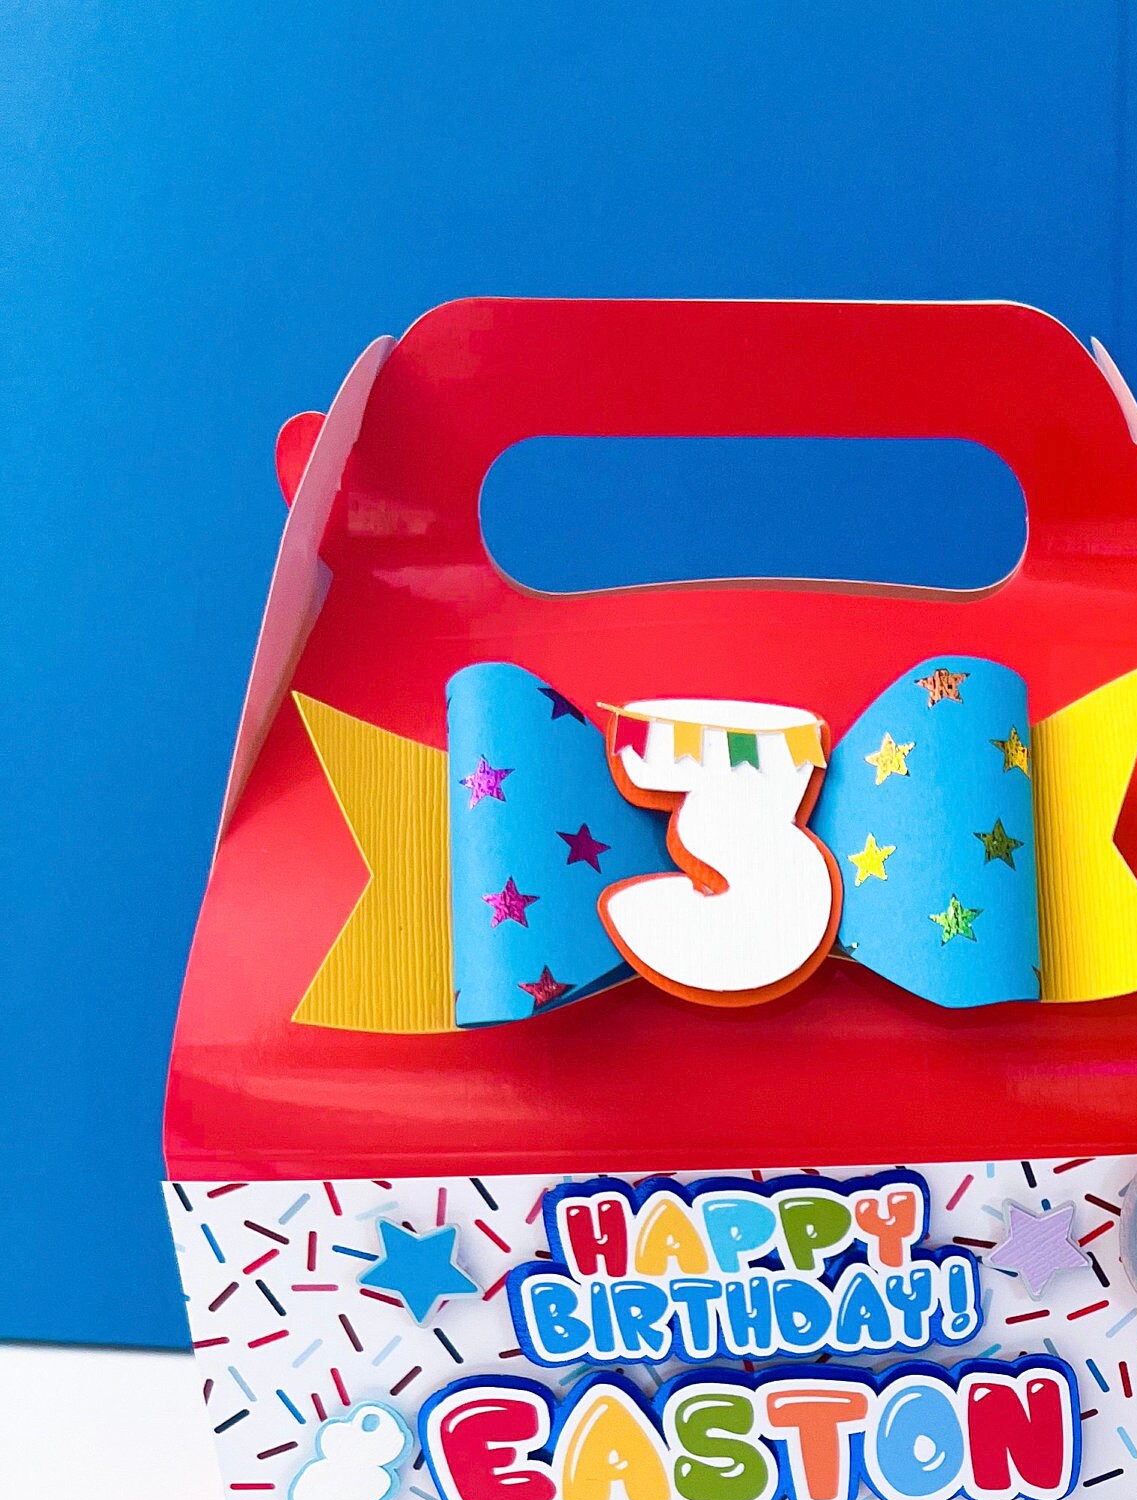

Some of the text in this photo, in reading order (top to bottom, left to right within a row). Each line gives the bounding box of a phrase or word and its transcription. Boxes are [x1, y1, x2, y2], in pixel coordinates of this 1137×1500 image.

[606, 698, 833, 992] 3
[566, 1191, 918, 1277] HAPPY
[530, 1265, 976, 1353] BIRTHDAY!
